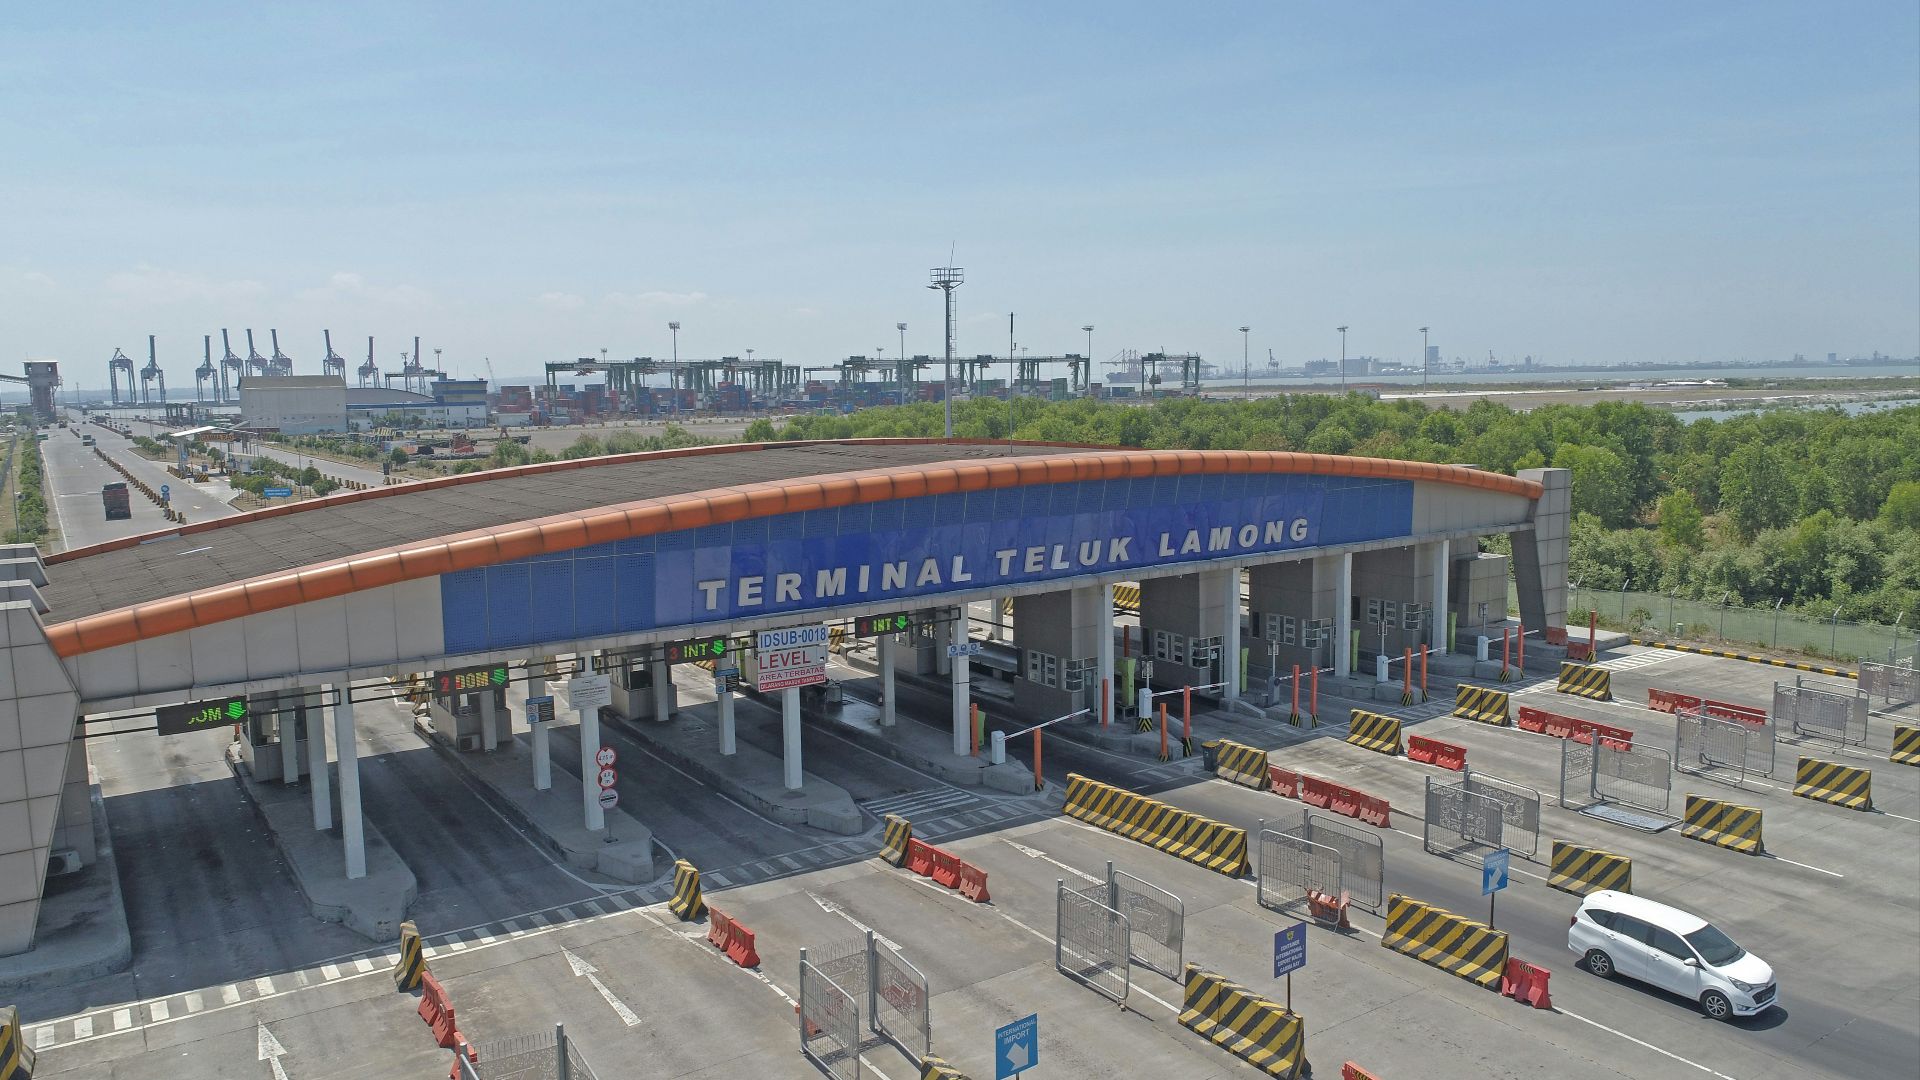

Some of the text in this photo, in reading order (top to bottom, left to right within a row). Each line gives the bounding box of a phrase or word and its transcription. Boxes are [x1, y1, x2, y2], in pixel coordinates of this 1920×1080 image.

[698, 518, 1308, 610] TERMINAL TELUK LAMONG
[873, 618, 892, 632] INT
[760, 627, 826, 648] IDSUB-0018
[683, 642, 708, 658] INT
[759, 650, 811, 670] LEVEL
[455, 671, 489, 689] DOM
[760, 666, 825, 681] AREA TERBATAS
[997, 1018, 1037, 1039] INTERNATIONAL
[1003, 1029, 1029, 1045] IMPORT
